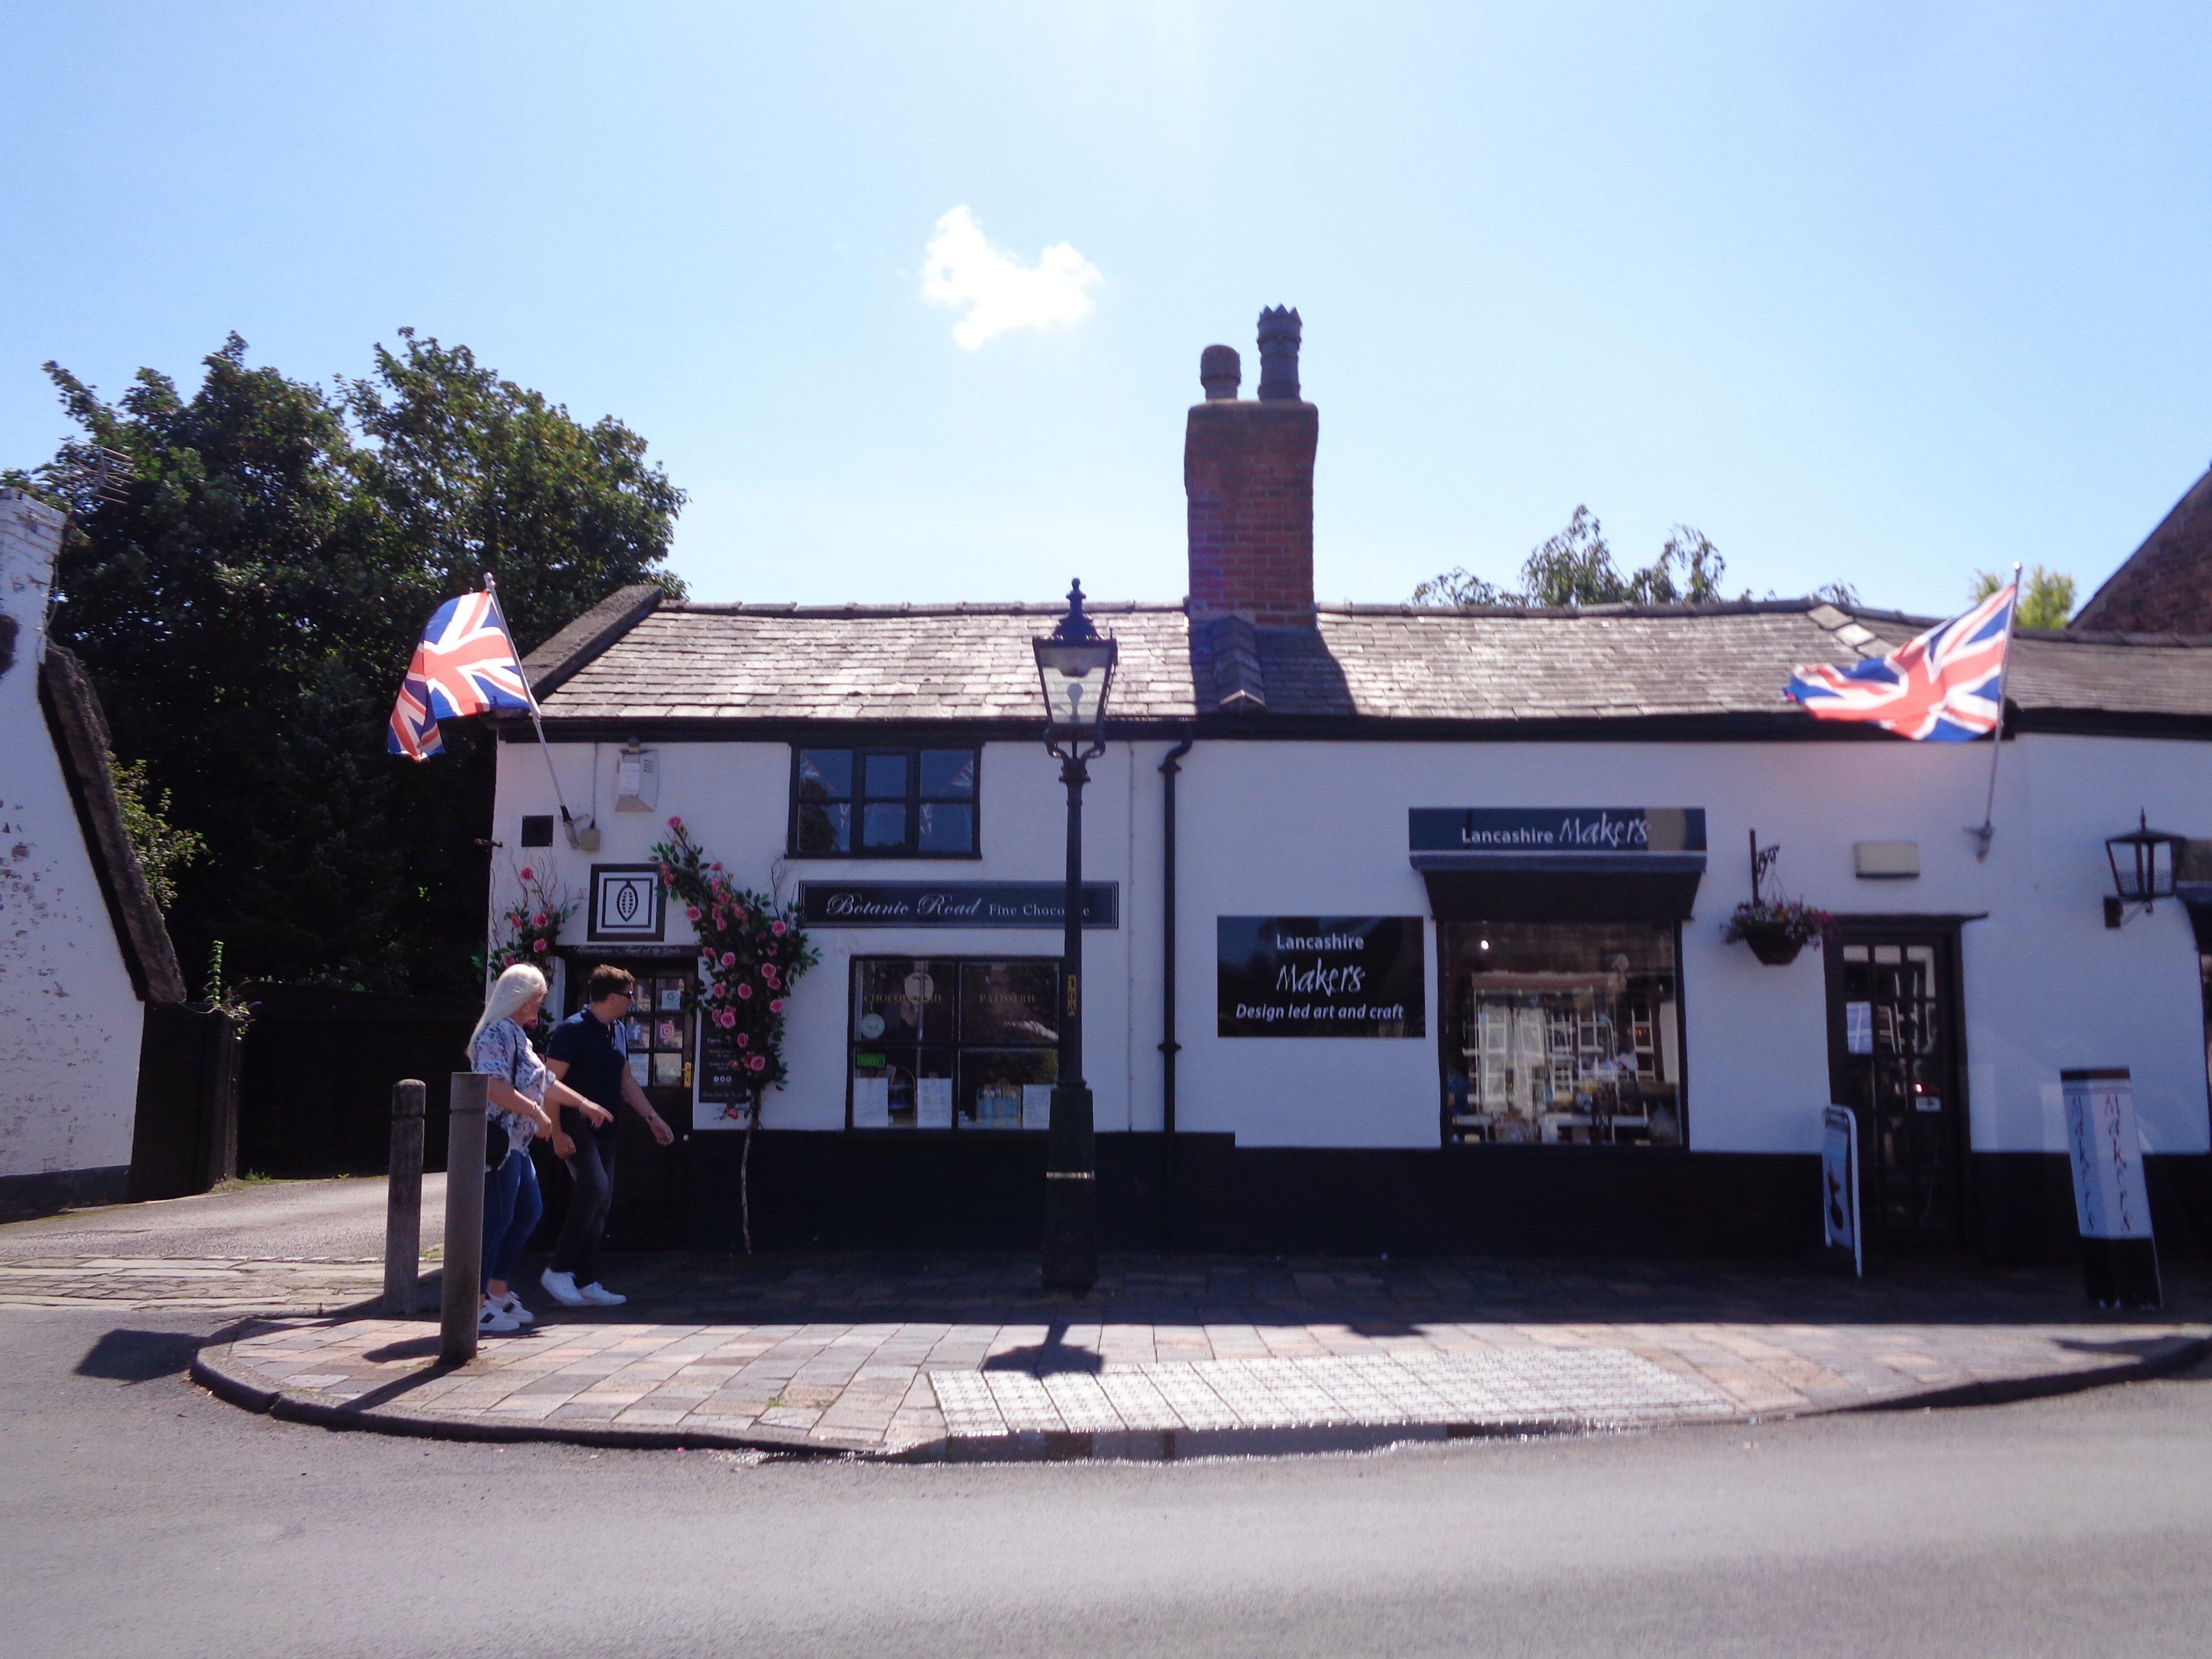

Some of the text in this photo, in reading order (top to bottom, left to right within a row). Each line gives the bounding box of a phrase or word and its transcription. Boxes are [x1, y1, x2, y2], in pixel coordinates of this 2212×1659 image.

[1462, 811, 1652, 848] Lancashire Makers
[825, 892, 1089, 916] Botanic Road Fine Chocoe
[1277, 933, 1364, 950] Lancashire
[1276, 957, 1366, 997] Makers
[1236, 1003, 1404, 1022] Design led art and craft
[2104, 1093, 2131, 1232] Makers
